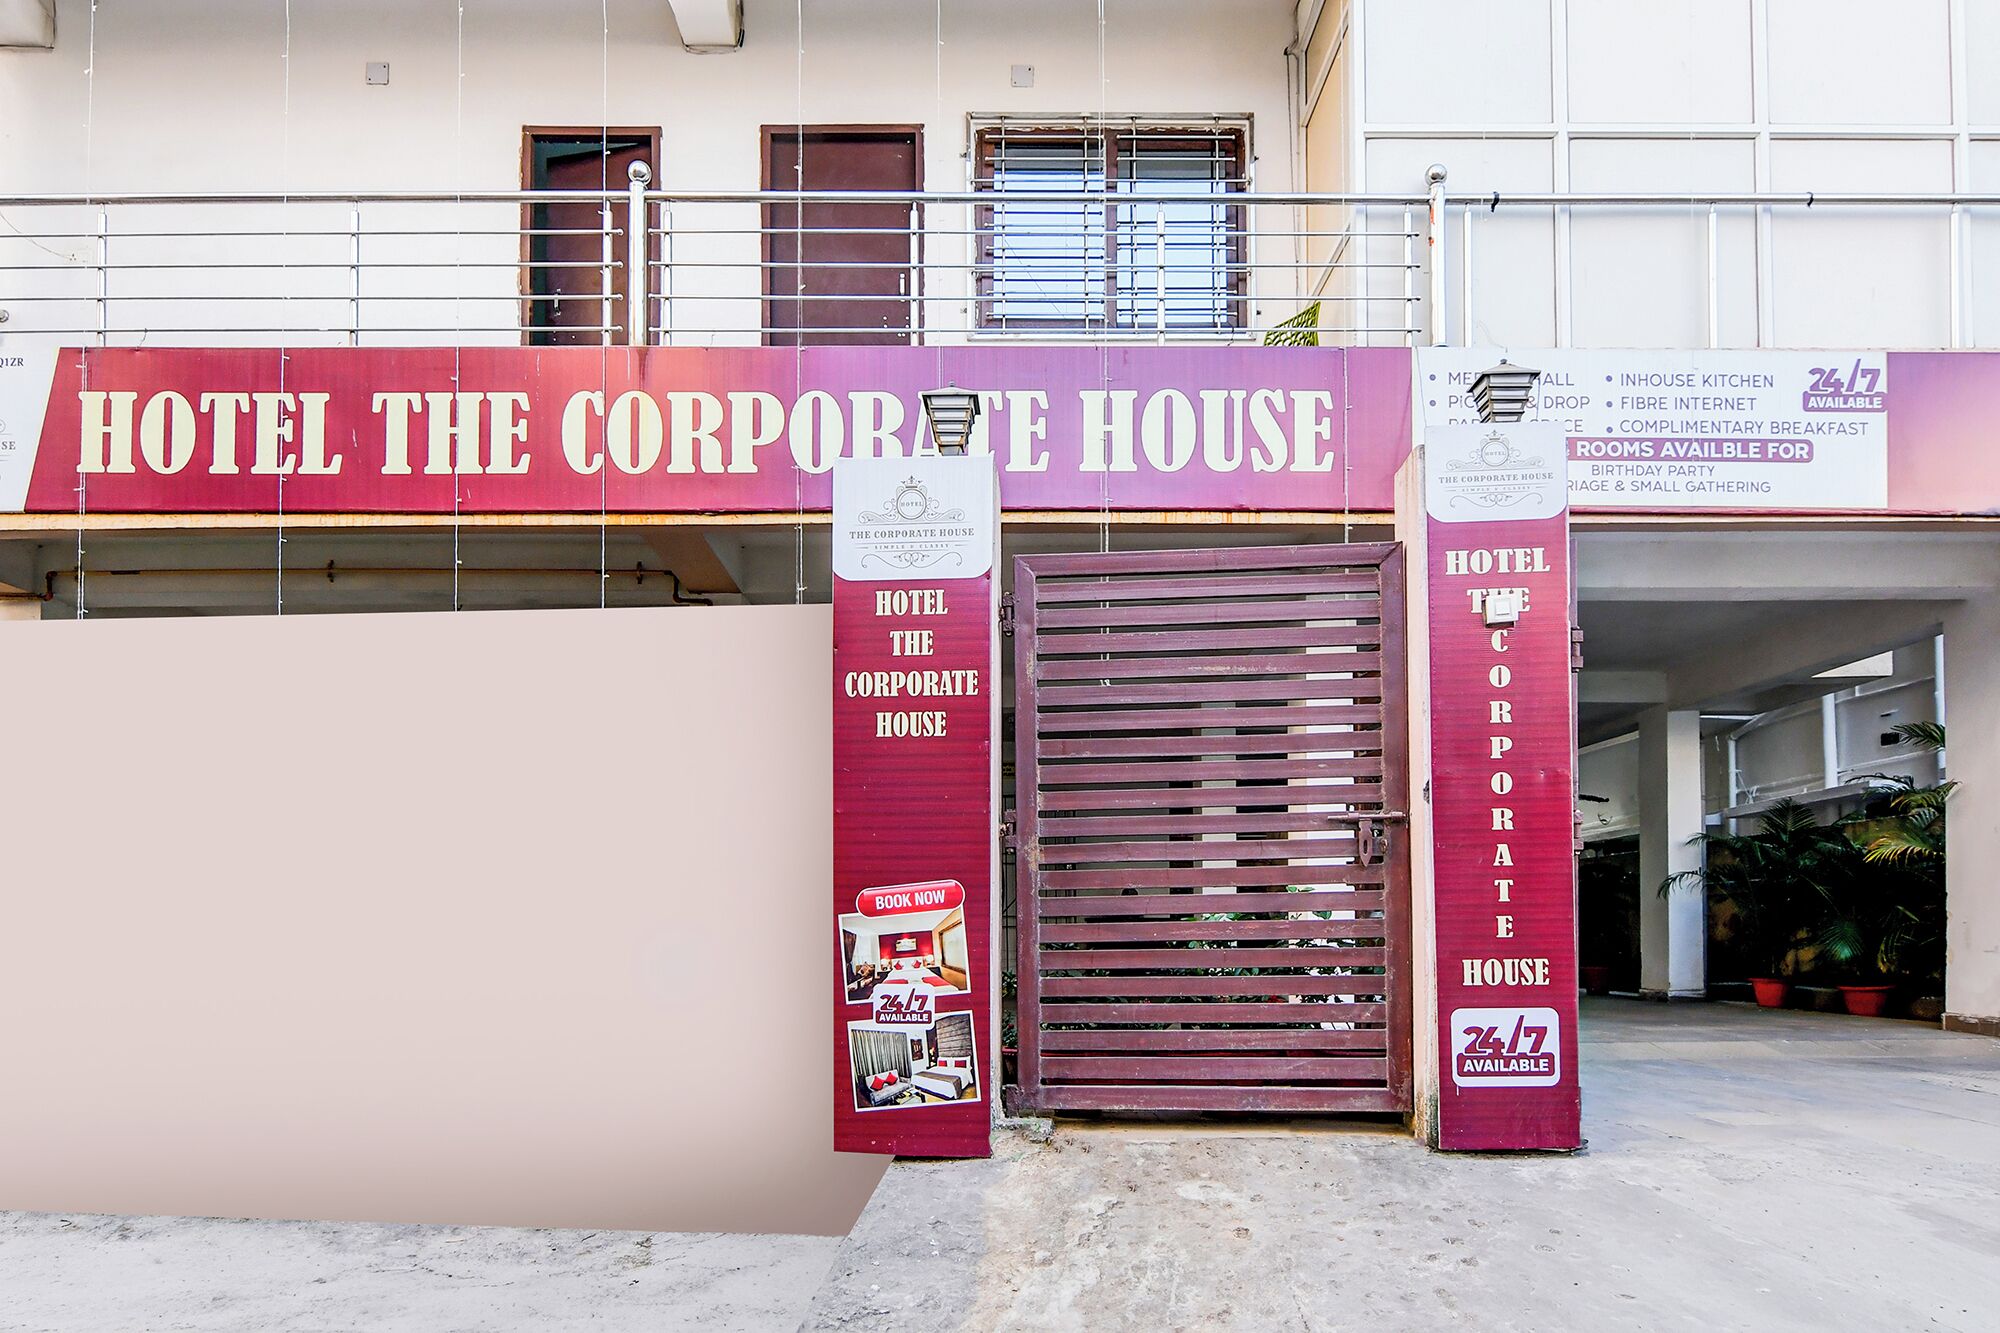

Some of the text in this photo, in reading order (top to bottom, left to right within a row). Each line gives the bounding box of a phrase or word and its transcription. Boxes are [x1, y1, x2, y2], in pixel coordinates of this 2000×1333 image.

[1620, 373, 1774, 388] INHOUSE KITCHEN
[1808, 358, 1881, 395] 24/7
[1543, 395, 1591, 409] DROP
[1621, 396, 1757, 411] FIBRE INTERNET
[1808, 396, 1882, 409] AVAILABLE
[76, 390, 344, 476] HOTEL
[371, 390, 532, 476] THE
[1078, 387, 1336, 475] HOUSE
[1619, 419, 1869, 436] COMPLIMENTARY BREAKFAST
[1576, 441, 1654, 458] ROOMS
[1659, 441, 1762, 459] AVAILBLE
[1767, 442, 1809, 459] FOR
[1438, 472, 1554, 484] THE CORPORATE HOUSE
[1591, 464, 1715, 477] BIRTHDAY PARTY
[1614, 480, 1626, 492] &
[1630, 480, 1680, 493] SMALL
[1685, 481, 1772, 493] GATHERING
[849, 527, 975, 539] THE CORPORATE HOUSE
[1445, 547, 1551, 576] HOTEL
[875, 589, 948, 616] HOTEL
[889, 630, 934, 657] THE
[844, 669, 979, 698] CORPORATE
[876, 711, 947, 738] HOUSE
[875, 889, 946, 911] BOOK NOW
[1462, 957, 1551, 987] HOUSE
[879, 987, 929, 1011] 24/7
[879, 1012, 930, 1022] AVAILABLE
[1462, 1014, 1549, 1056] 24/7
[1462, 1058, 1550, 1073] AVAILABLE
